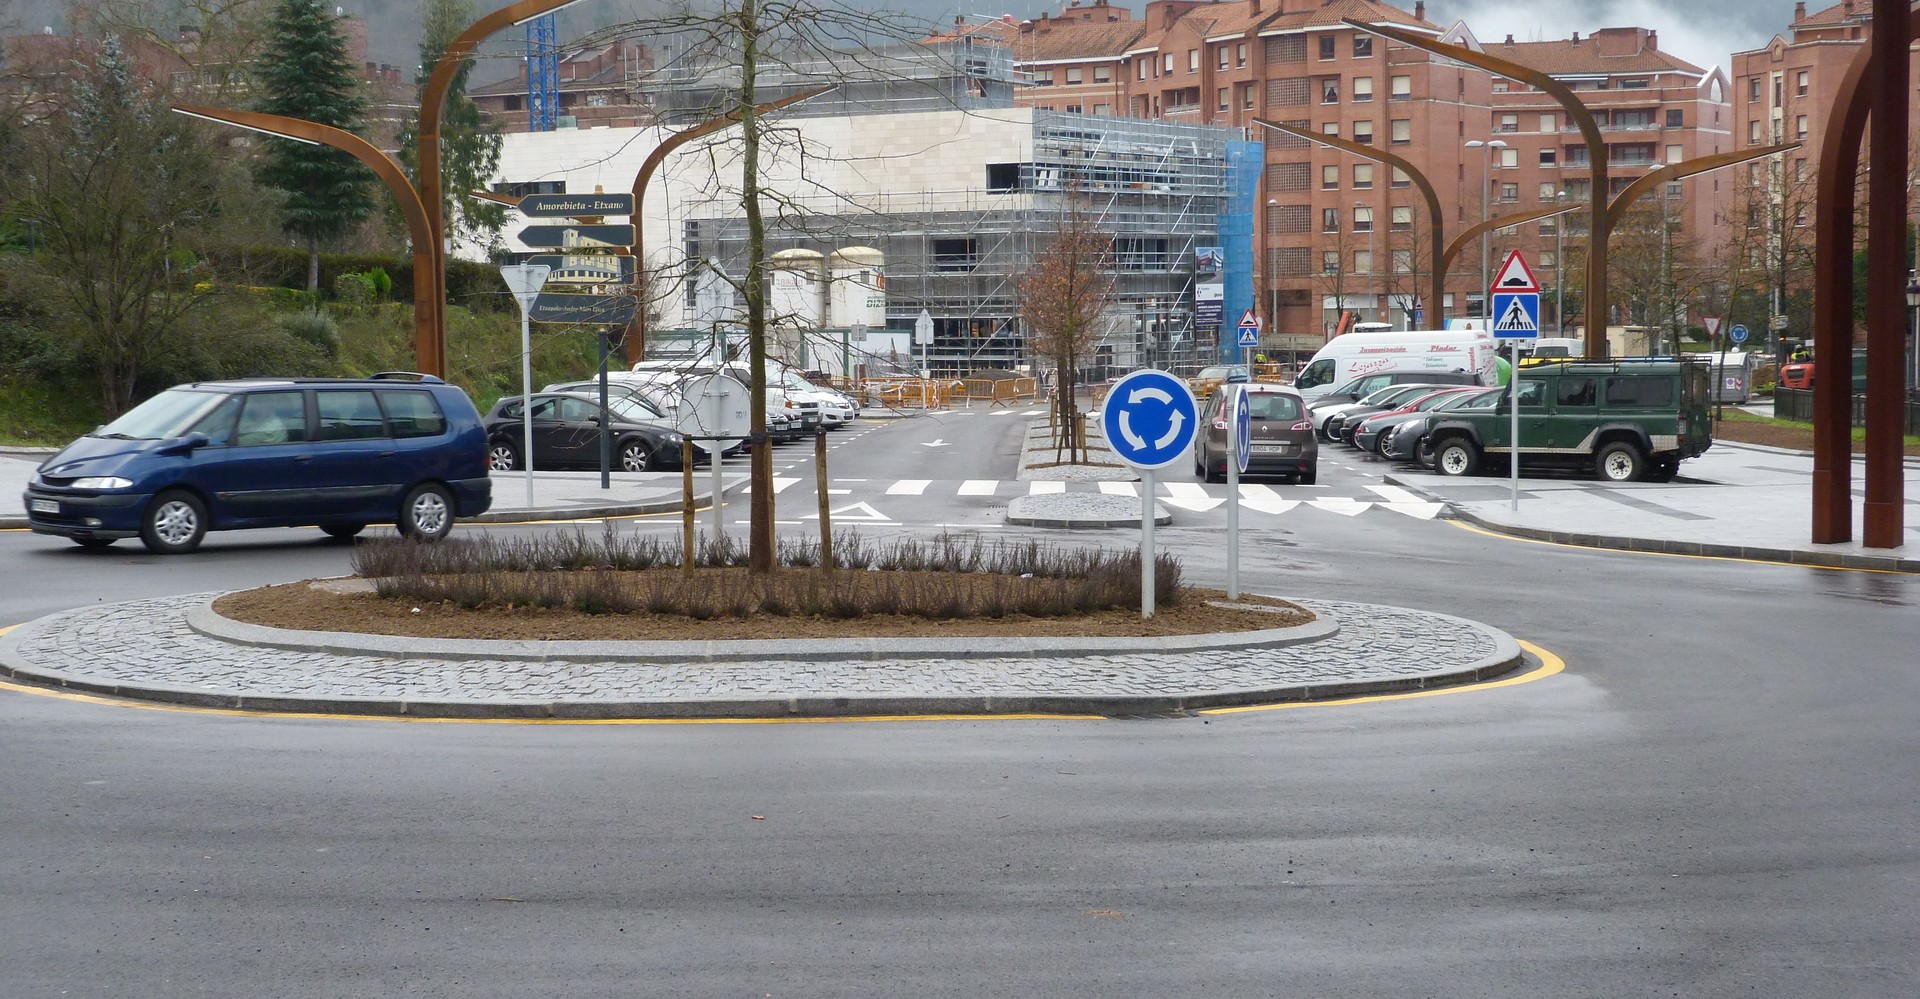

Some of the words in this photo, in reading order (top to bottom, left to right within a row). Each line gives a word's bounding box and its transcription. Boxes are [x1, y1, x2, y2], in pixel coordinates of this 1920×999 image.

[536, 202, 586, 211] Amorebieta
[594, 201, 624, 210] Etxano
[1430, 344, 1457, 352] Pladur
